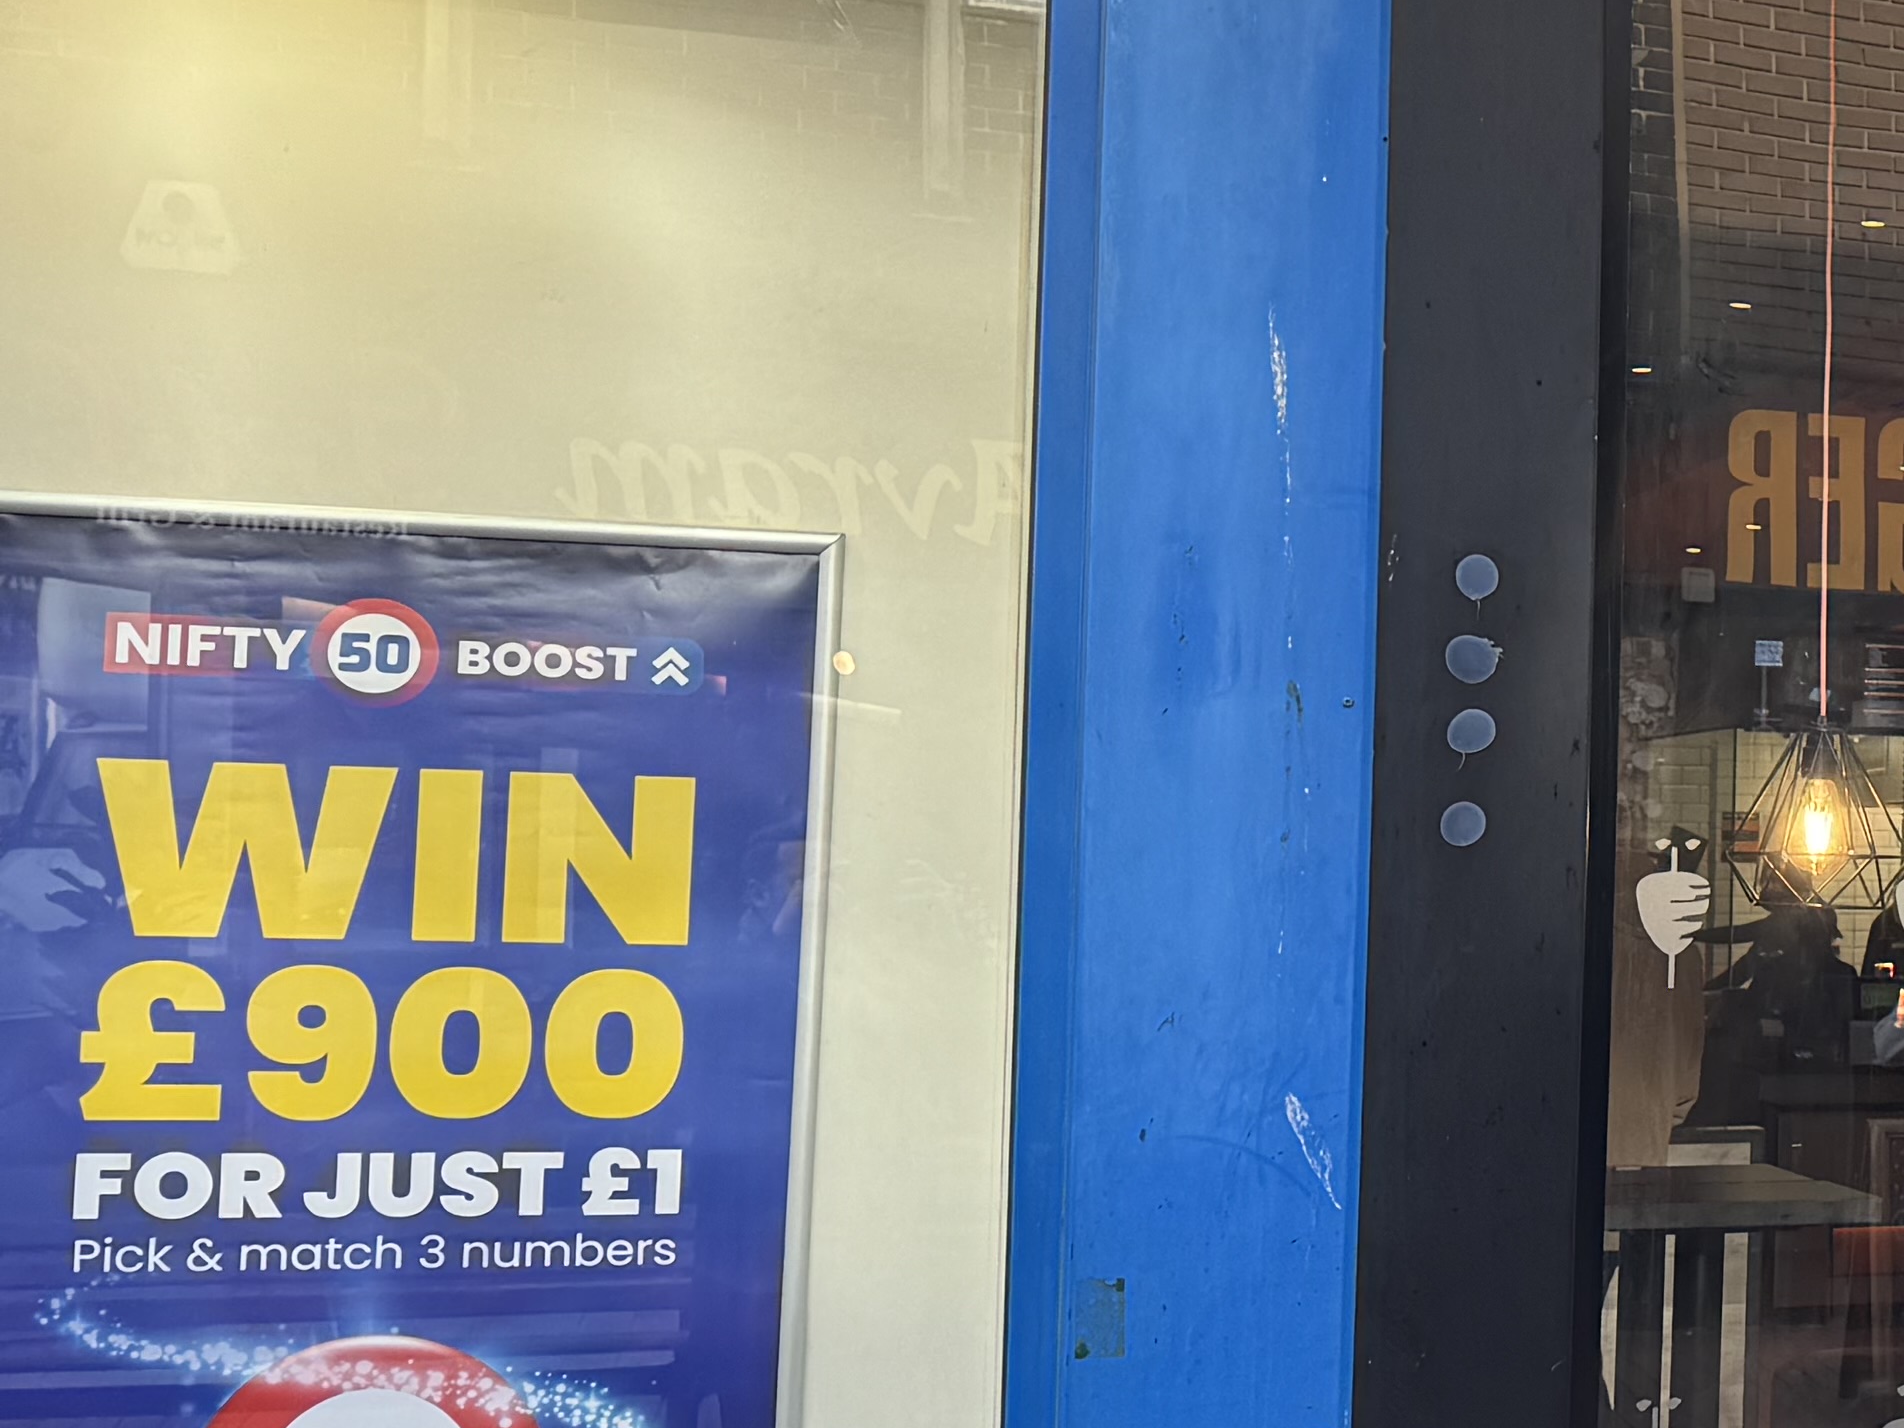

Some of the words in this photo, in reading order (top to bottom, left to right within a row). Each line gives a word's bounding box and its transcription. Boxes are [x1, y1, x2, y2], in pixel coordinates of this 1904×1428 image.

[114, 620, 306, 672] NIFTY
[328, 631, 411, 676] 50
[457, 639, 638, 682] BOOST
[96, 757, 697, 946] WIN
[79, 959, 685, 1122] £900
[72, 1152, 286, 1220] FOR
[303, 1150, 565, 1218] JUST
[581, 1146, 684, 1217] £1
[73, 1235, 173, 1274] Pick
[186, 1238, 224, 1274] &
[240, 1235, 402, 1272] match
[420, 1235, 446, 1269] 3
[462, 1233, 677, 1269] numbers
